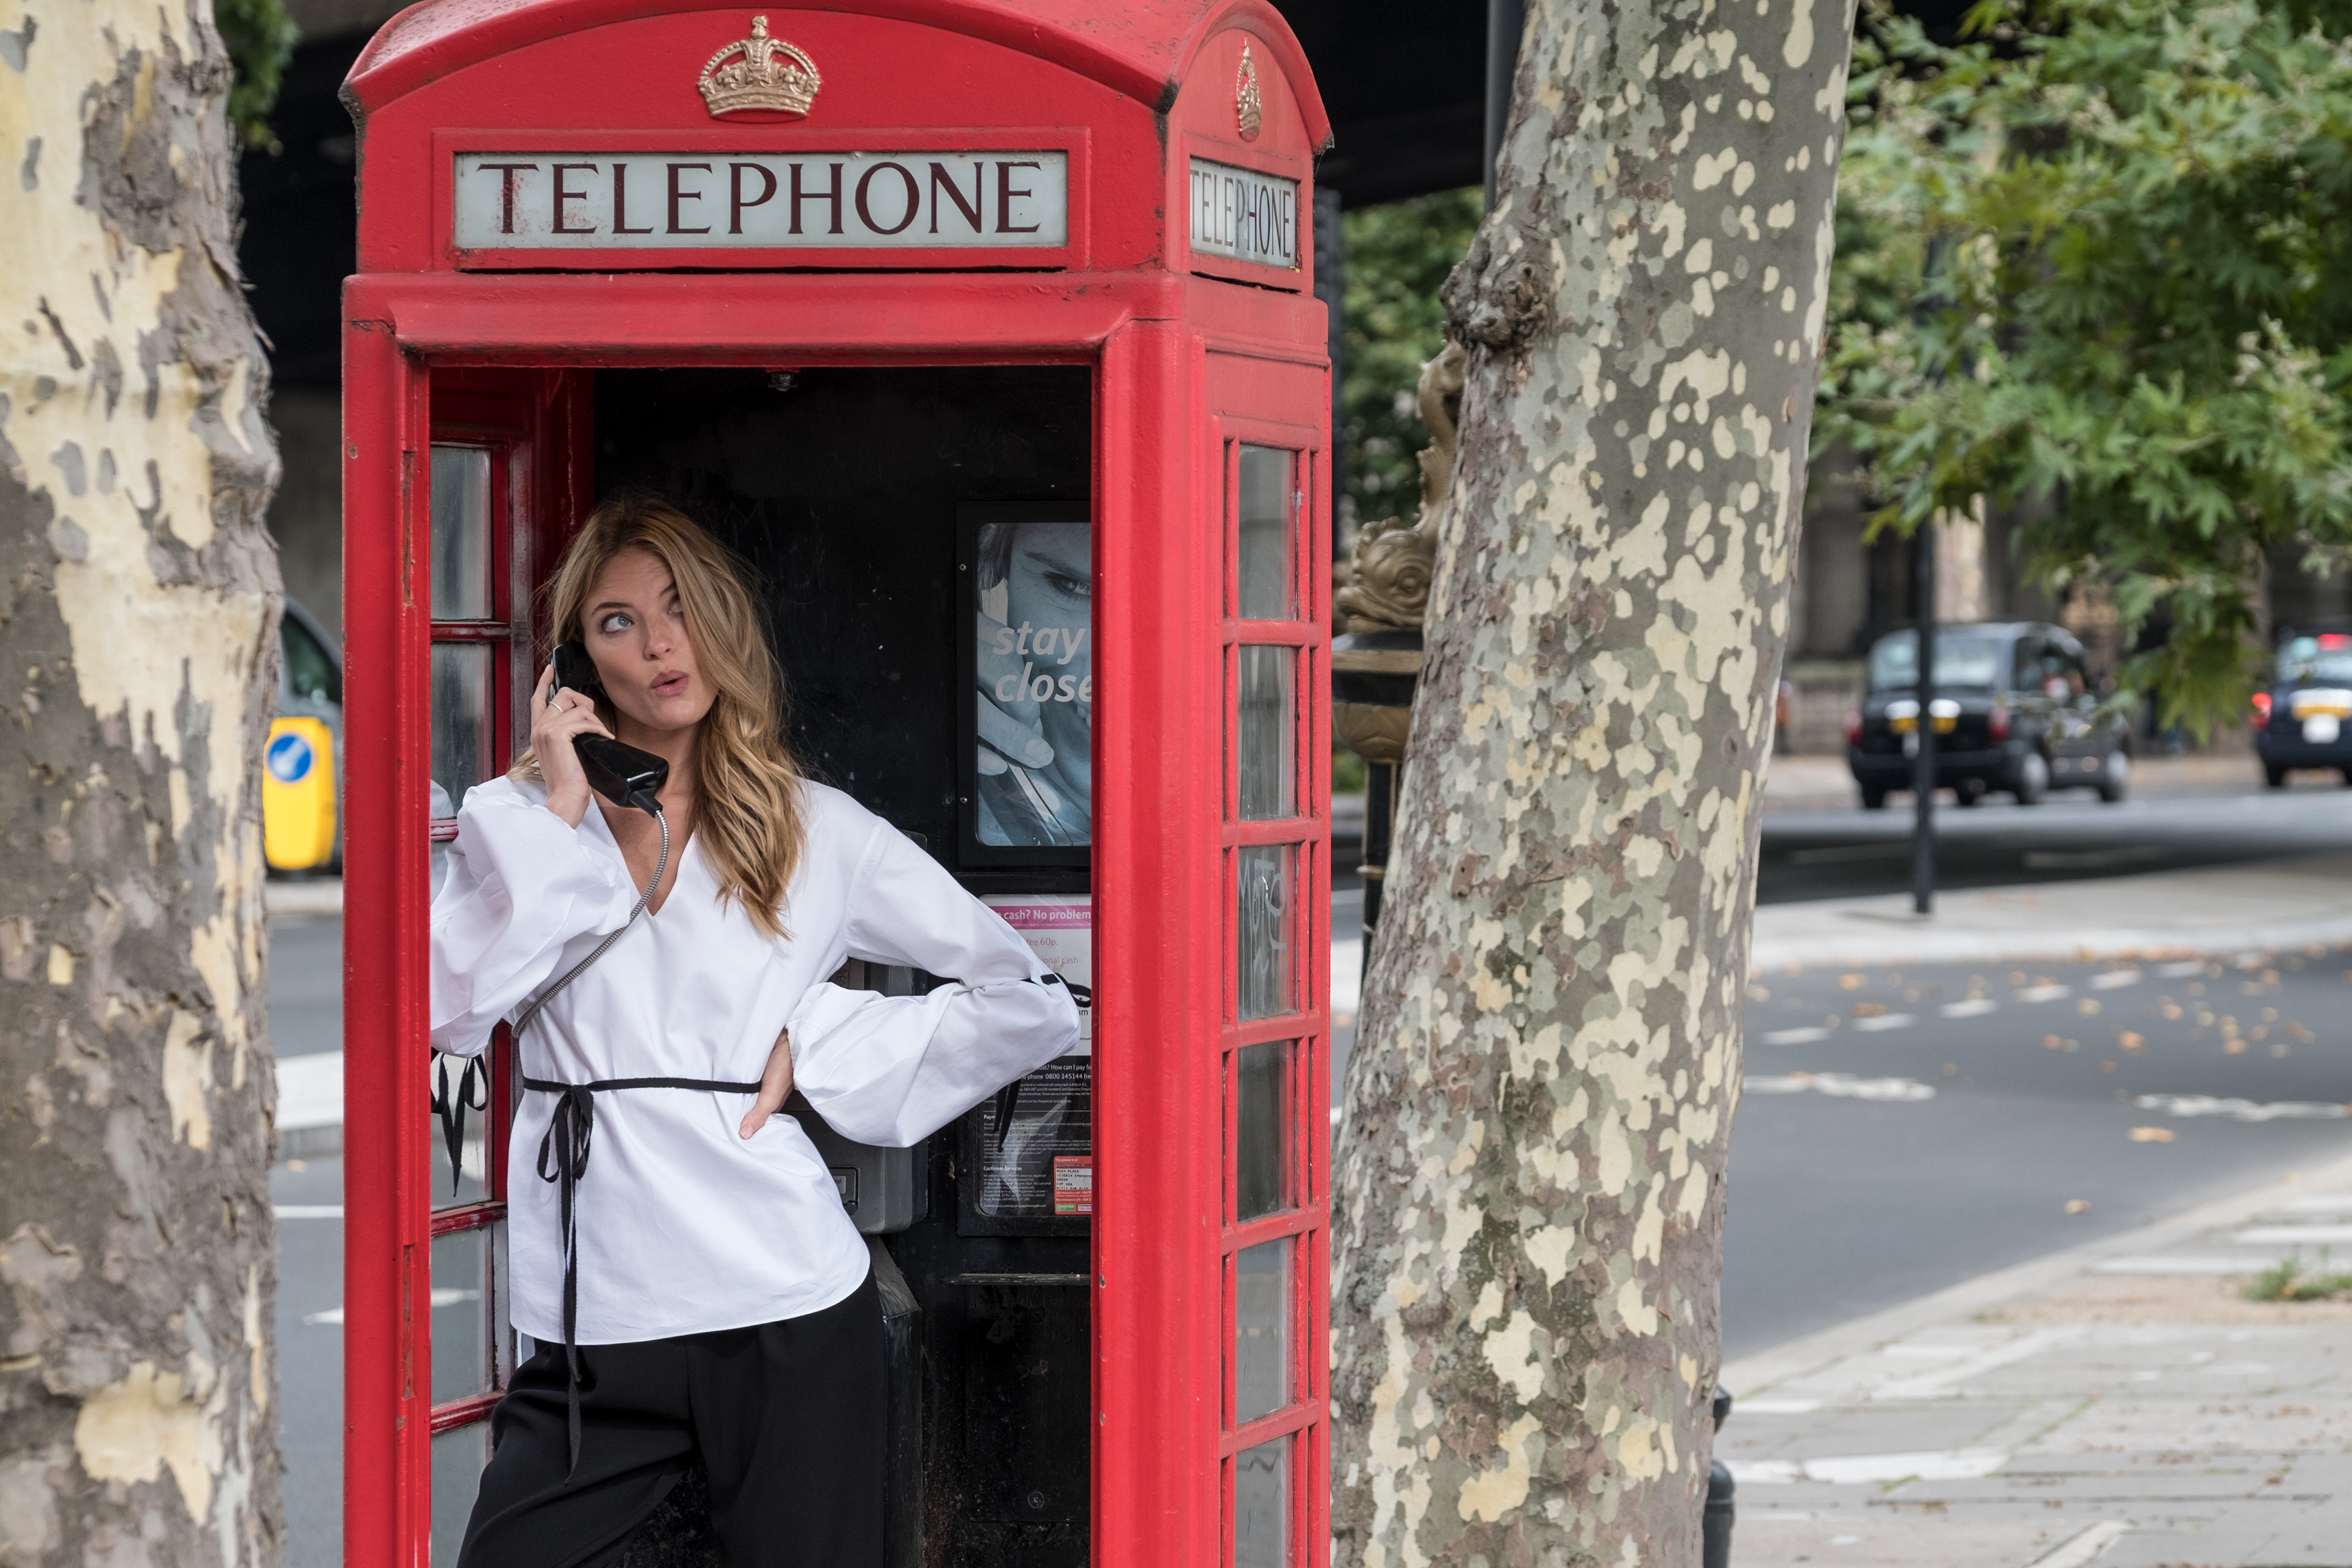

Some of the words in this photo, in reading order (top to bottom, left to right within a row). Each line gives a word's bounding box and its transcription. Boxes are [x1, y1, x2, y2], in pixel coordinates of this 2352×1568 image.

[477, 160, 1043, 235] TELEPHONE
[1189, 168, 1291, 258] TELEPHONE
[992, 620, 1087, 665] stay
[995, 661, 1092, 703] close
[1003, 909, 1031, 919] cash?
[1033, 909, 1047, 919] No
[1049, 909, 1091, 921] problem
[1041, 938, 1058, 947] 60p.
